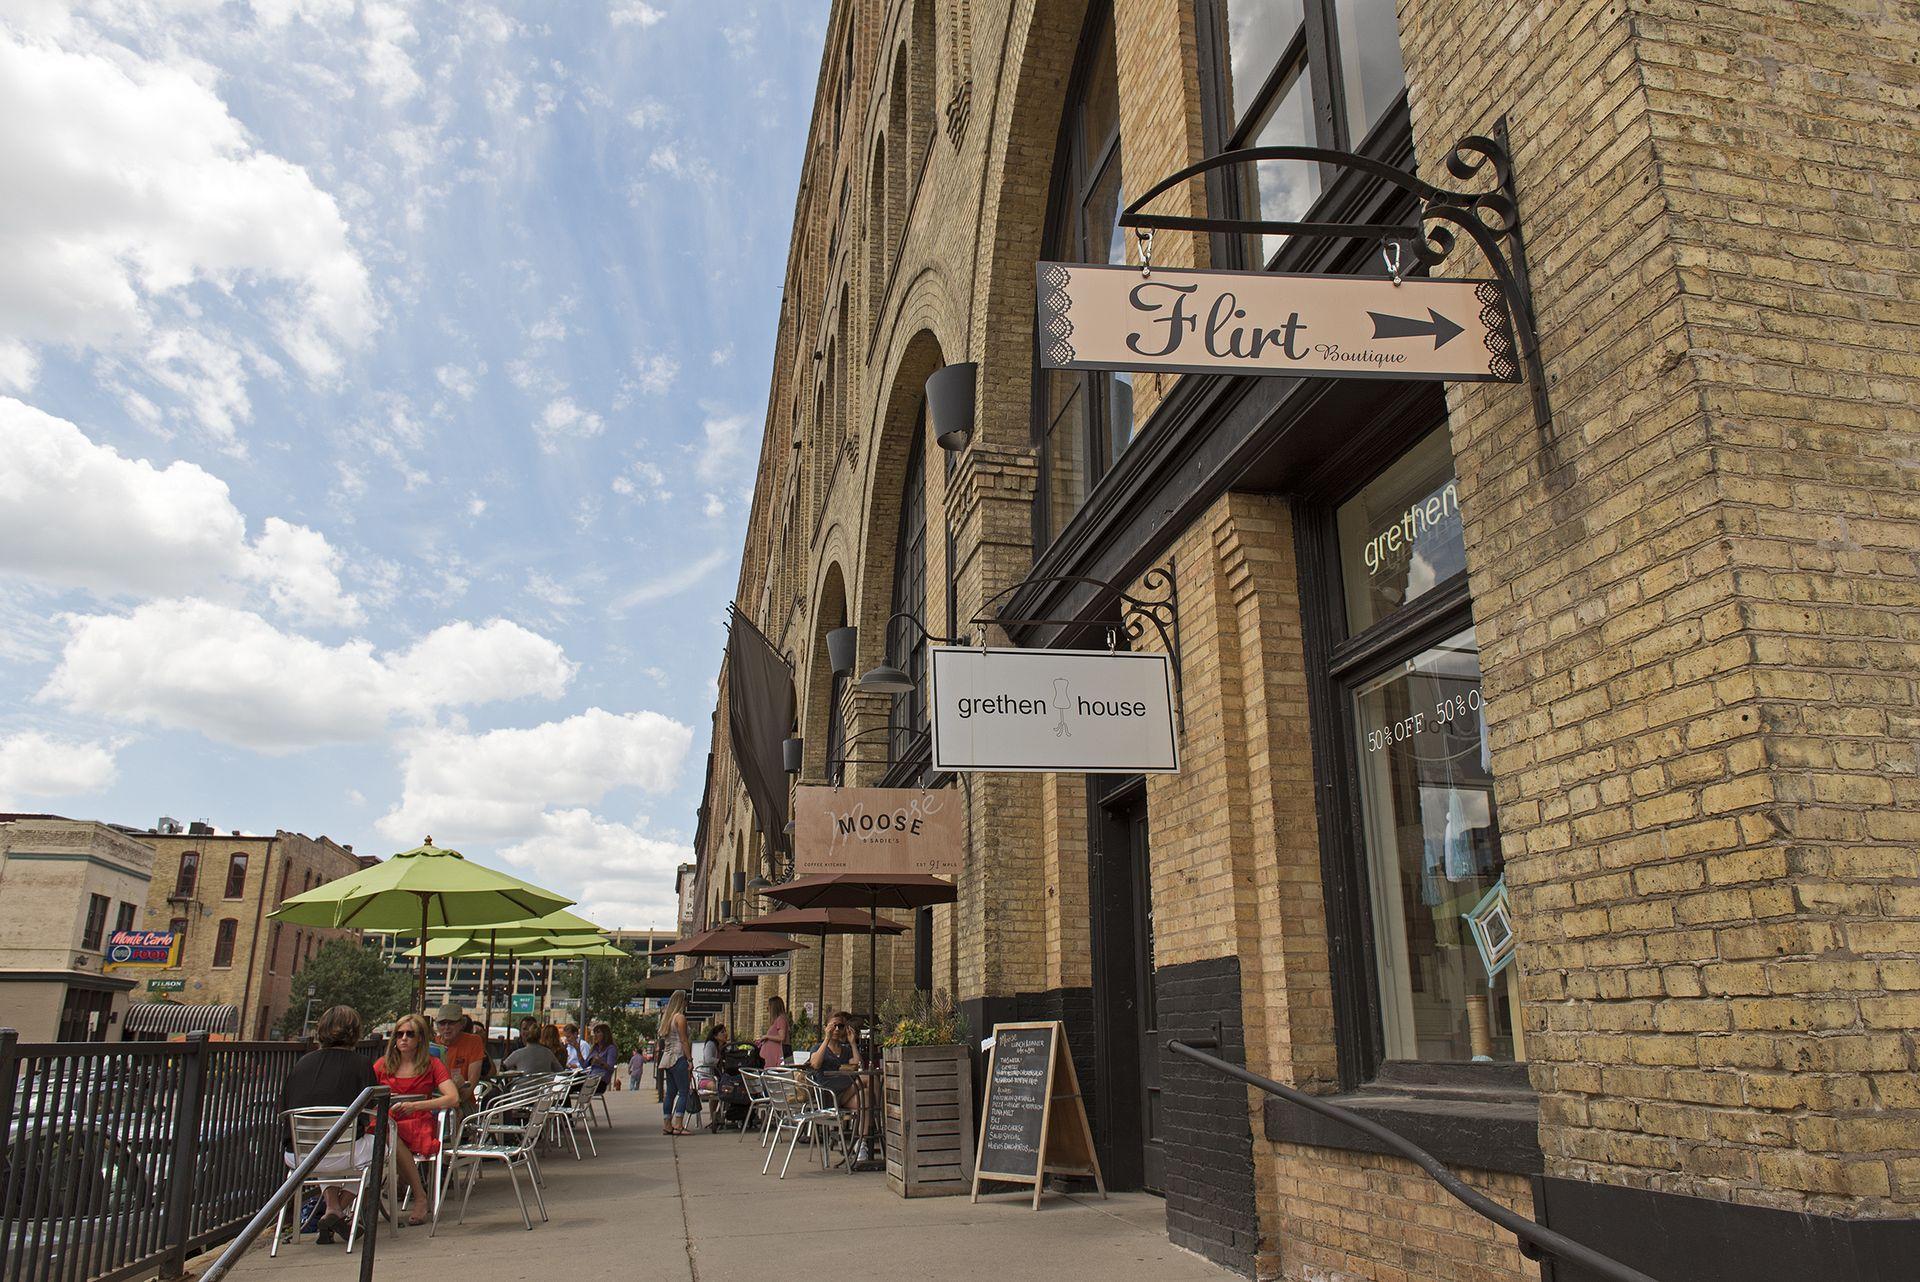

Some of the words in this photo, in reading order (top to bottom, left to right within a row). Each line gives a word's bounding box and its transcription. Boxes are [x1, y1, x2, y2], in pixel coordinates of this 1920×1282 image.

[1125, 281, 1309, 361] Flirt
[1314, 343, 1408, 368] Boutique
[1364, 484, 1459, 575] grethen
[958, 694, 1046, 719] grethen
[1077, 696, 1146, 717] house
[837, 814, 924, 836] MOOSE
[112, 931, 143, 945] Monte
[143, 932, 173, 945] Carlo
[132, 950, 167, 959] FOOD
[733, 960, 784, 968] ENTRANCE
